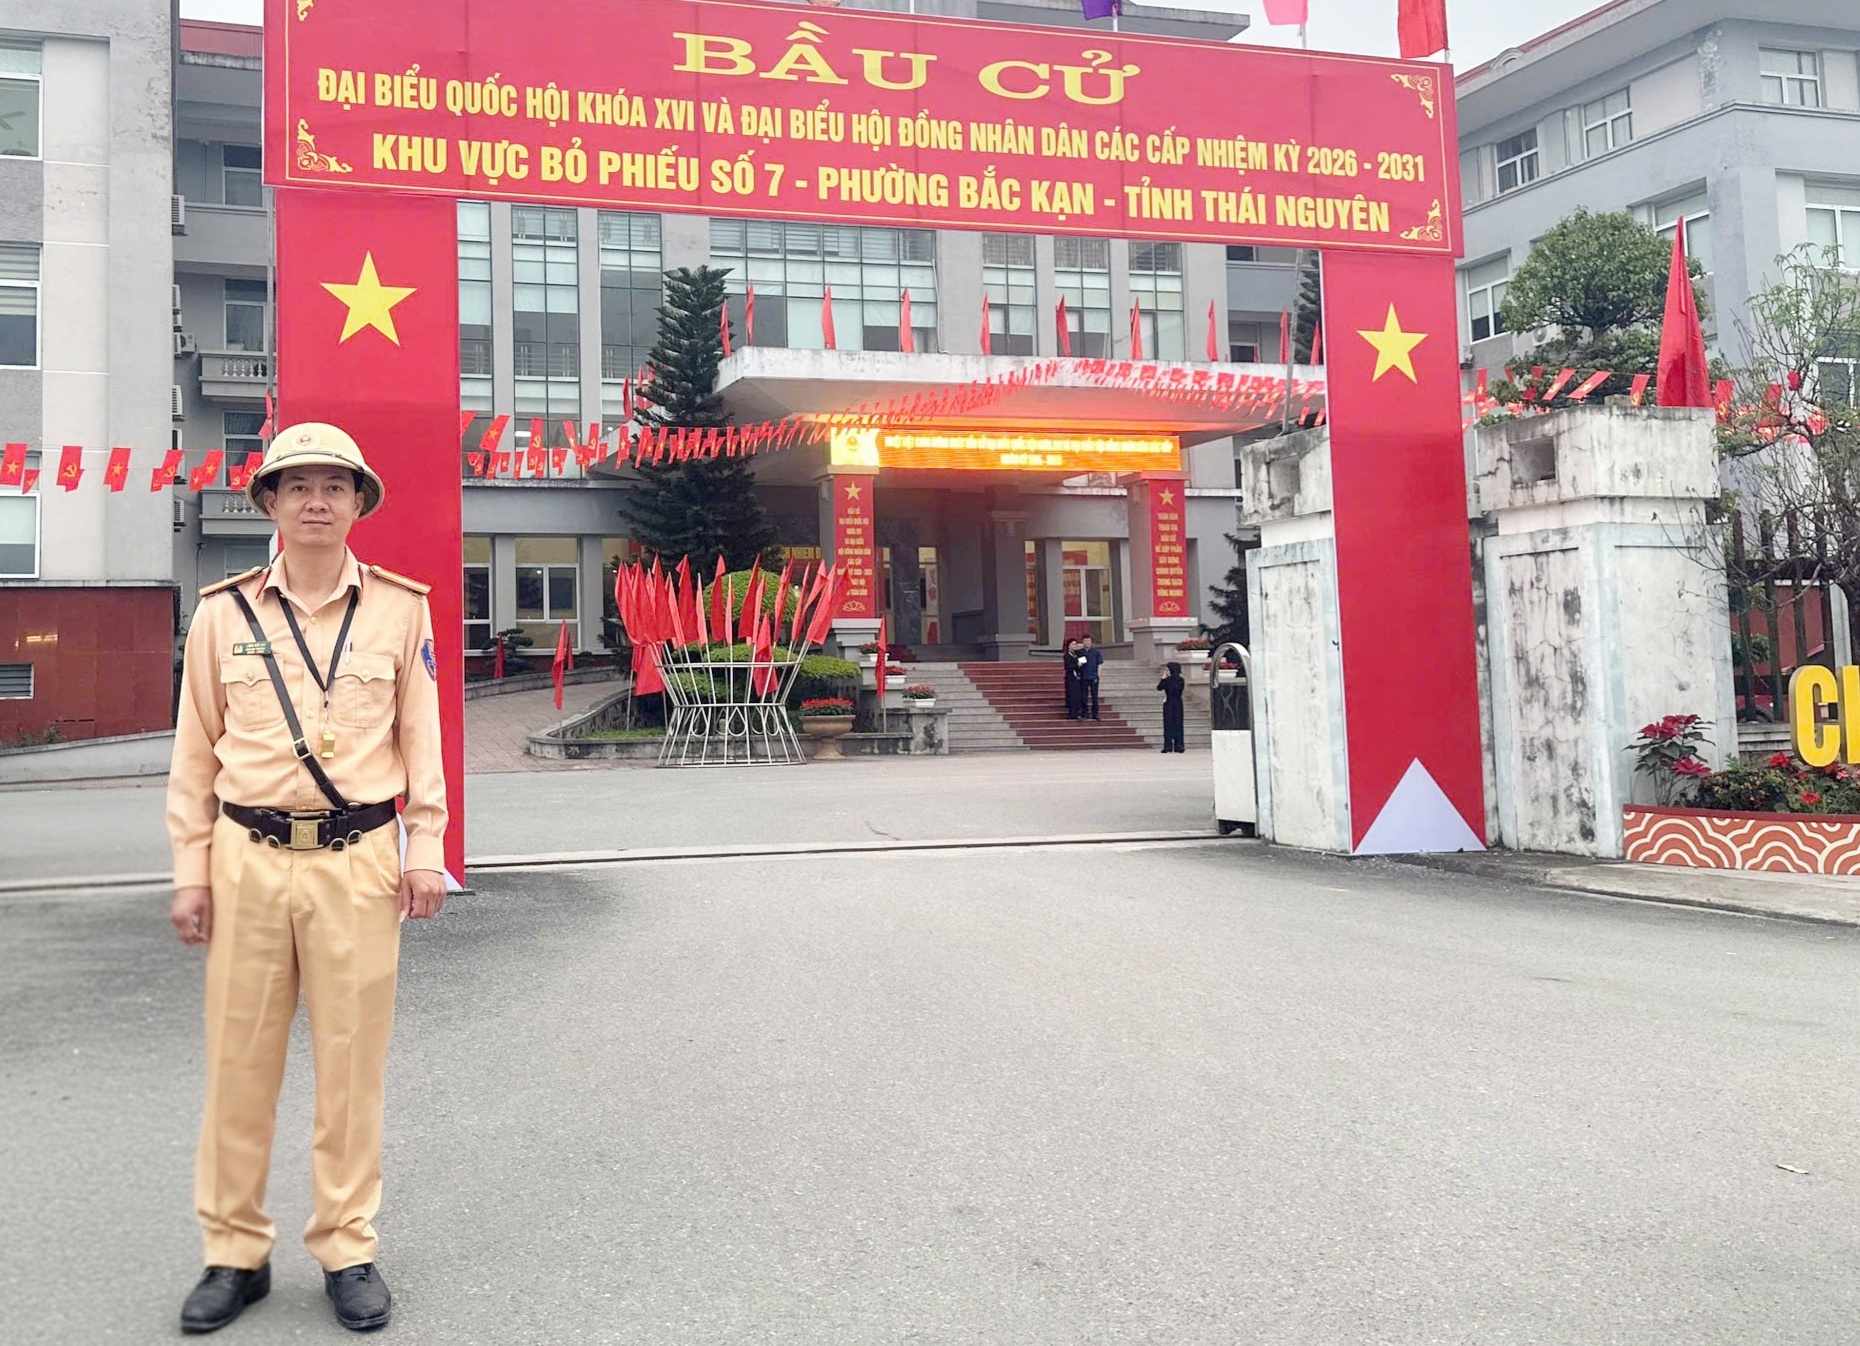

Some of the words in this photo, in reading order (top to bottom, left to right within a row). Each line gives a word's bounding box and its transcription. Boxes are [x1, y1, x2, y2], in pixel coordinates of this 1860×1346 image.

[672, 20, 937, 91] BẦU
[979, 49, 1141, 105] CỬ
[318, 68, 365, 111] ĐẠI
[374, 63, 438, 111] BIỂU
[446, 72, 518, 118] QUỐC
[526, 82, 570, 128] HỘI
[578, 88, 645, 128] KHÓA
[655, 97, 695, 132] XVI
[702, 96, 733, 135] VÀ
[741, 105, 783, 144] ĐẠI
[790, 99, 845, 143] BIỂU
[852, 109, 892, 152] HỘI
[898, 108, 963, 151] ĐỒNG
[970, 119, 1035, 156] NHÂN
[1041, 123, 1089, 159] DÂN
[1095, 127, 1140, 163] CÁC
[1147, 127, 1191, 165] CẤP
[1197, 135, 1268, 175] NHIỆM
[1274, 139, 1301, 176] KỲ
[1307, 146, 1358, 178] 2026
[1378, 151, 1425, 182] 2031
[373, 132, 447, 174] KHU
[459, 139, 529, 186] VỰC
[541, 136, 588, 184] BỎ
[599, 149, 699, 192] PHIẾU
[711, 149, 755, 196] SỐ
[765, 163, 785, 197] 7
[818, 162, 949, 208] PHƯỜNG
[958, 165, 1022, 213] BẮC
[1031, 179, 1095, 221] KẠN
[1124, 175, 1194, 221] TỈNH
[1200, 187, 1267, 225] THÁI
[1276, 192, 1390, 233] NGUYÊN
